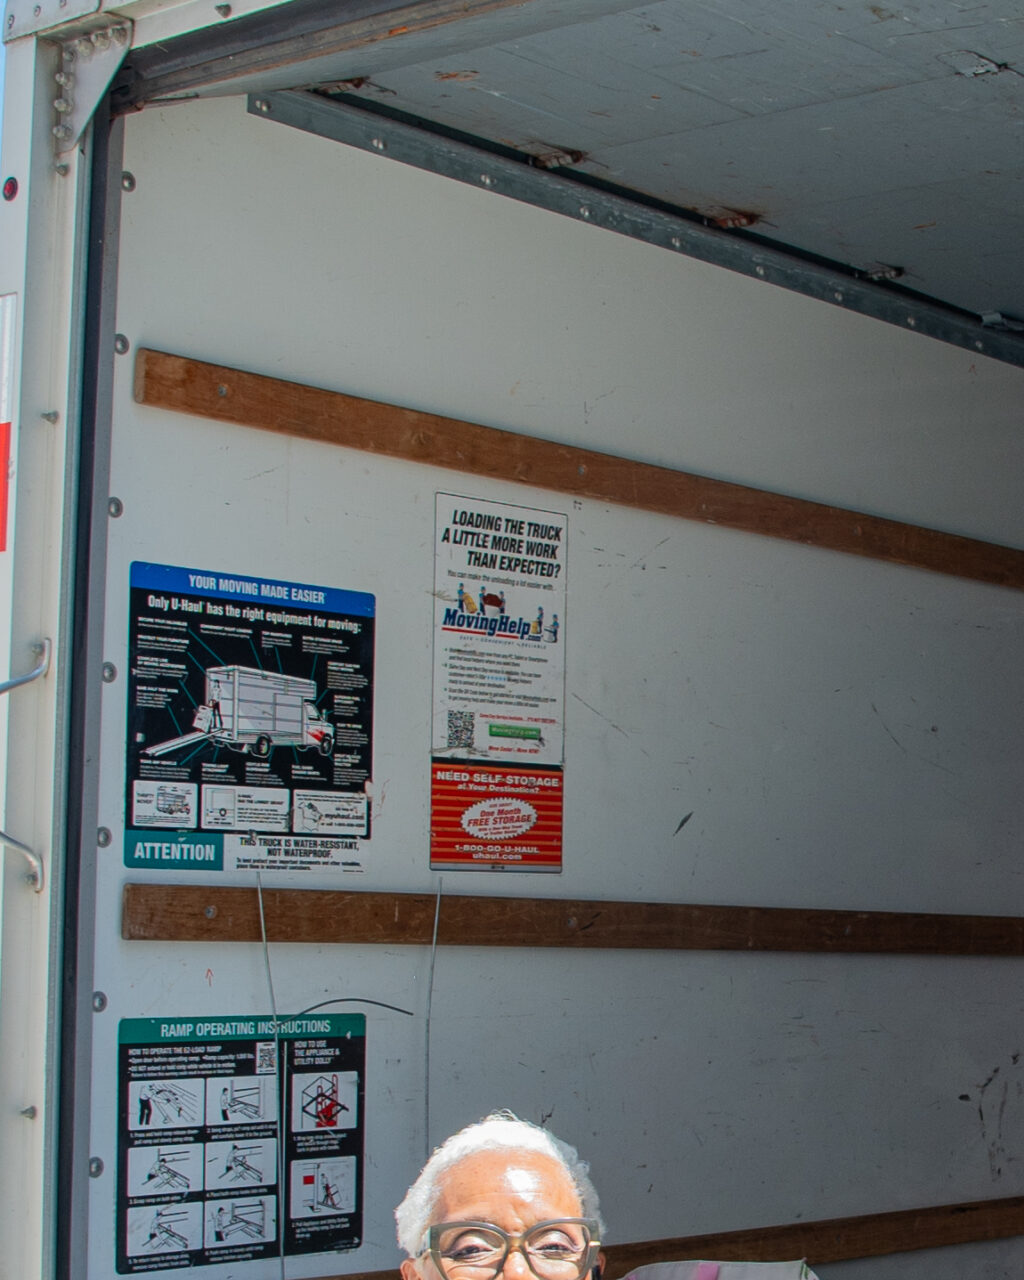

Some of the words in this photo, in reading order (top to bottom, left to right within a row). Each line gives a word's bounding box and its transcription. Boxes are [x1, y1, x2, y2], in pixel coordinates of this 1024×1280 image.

[452, 510, 502, 531] LOADING
[504, 518, 525, 535] THE
[527, 522, 562, 542] TRUCK
[442, 528, 450, 542] A
[452, 529, 490, 549] LITTLE
[491, 535, 524, 554] MORE
[526, 540, 559, 559] WORK
[468, 551, 497, 569] THAN
[499, 556, 561, 578] EXPECTED?
[189, 574, 216, 590] YOUR
[218, 579, 258, 595] MOVING
[261, 584, 289, 600] MADE
[291, 588, 325, 604] EASIER
[148, 595, 169, 611] Only
[171, 597, 202, 613] U-Haul
[206, 602, 223, 615] has
[226, 605, 240, 618] the
[242, 606, 264, 621] right
[266, 611, 312, 626] equipment
[314, 616, 326, 627] for
[437, 771, 469, 781] NEED
[473, 773, 559, 787] SELF-STORAGE
[489, 785, 539, 794] Destination?
[497, 808, 521, 816] Month
[467, 818, 490, 827] FREE
[492, 814, 532, 825] STORAGE
[134, 842, 215, 861] ATTENTION
[240, 837, 256, 846] THIS
[259, 838, 282, 847] TRUCK
[285, 839, 292, 847] IS
[294, 840, 359, 851] WATER-RESISTANT,
[267, 848, 282, 856] NOT
[284, 849, 333, 858] WATERPROOF.
[161, 1024, 193, 1037] RAMP
[196, 1022, 254, 1036] OPERATING
[258, 1020, 331, 1034] INSTRUCTIONS
[295, 1040, 307, 1048] HOW
